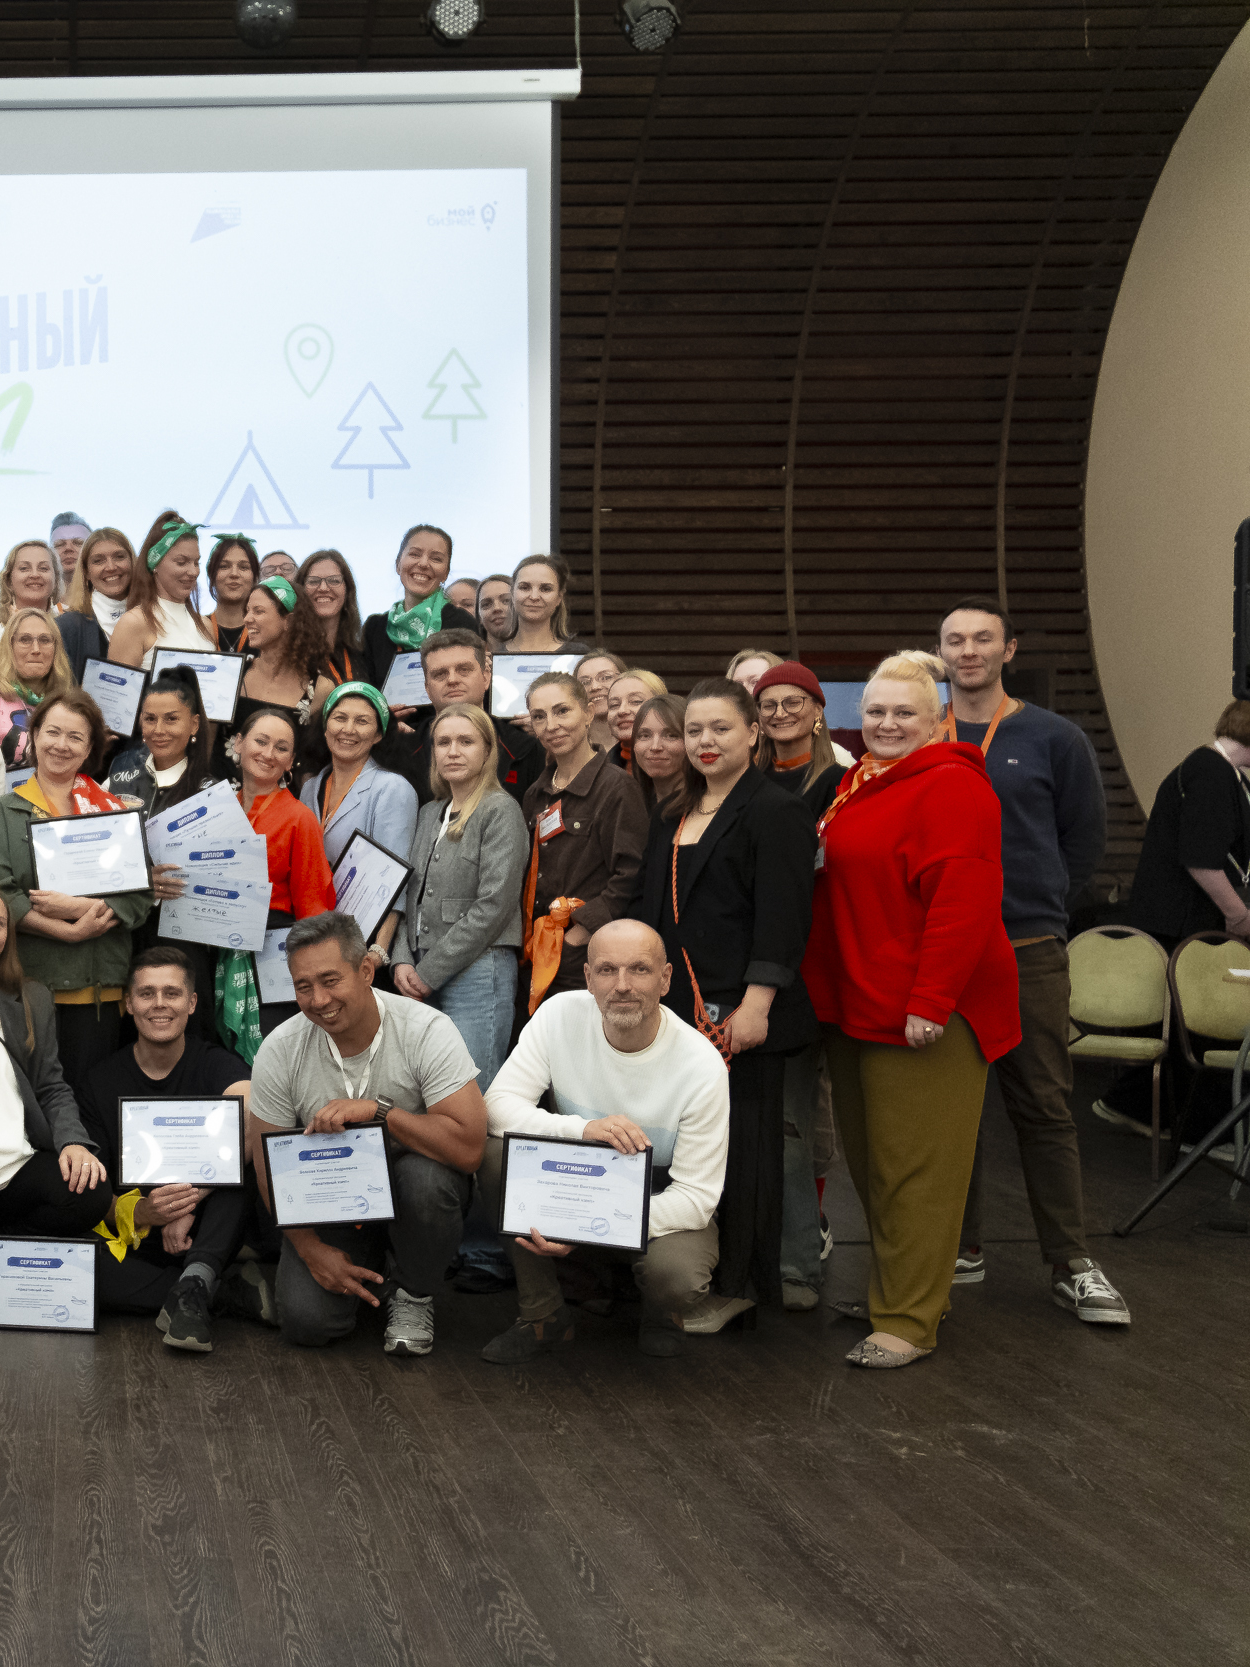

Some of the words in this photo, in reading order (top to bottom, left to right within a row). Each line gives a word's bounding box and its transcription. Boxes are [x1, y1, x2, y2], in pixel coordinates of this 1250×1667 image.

[447, 205, 475, 217] мой
[427, 213, 475, 226] бизнес
[177, 811, 198, 827] ДИПЛОМ
[201, 852, 225, 860] ДИПЛОМ
[205, 888, 229, 897] ДИПЛОМ
[310, 1150, 342, 1158] СЕРТИФИКАТ
[556, 1163, 593, 1173] СЕРТИФИКАТ
